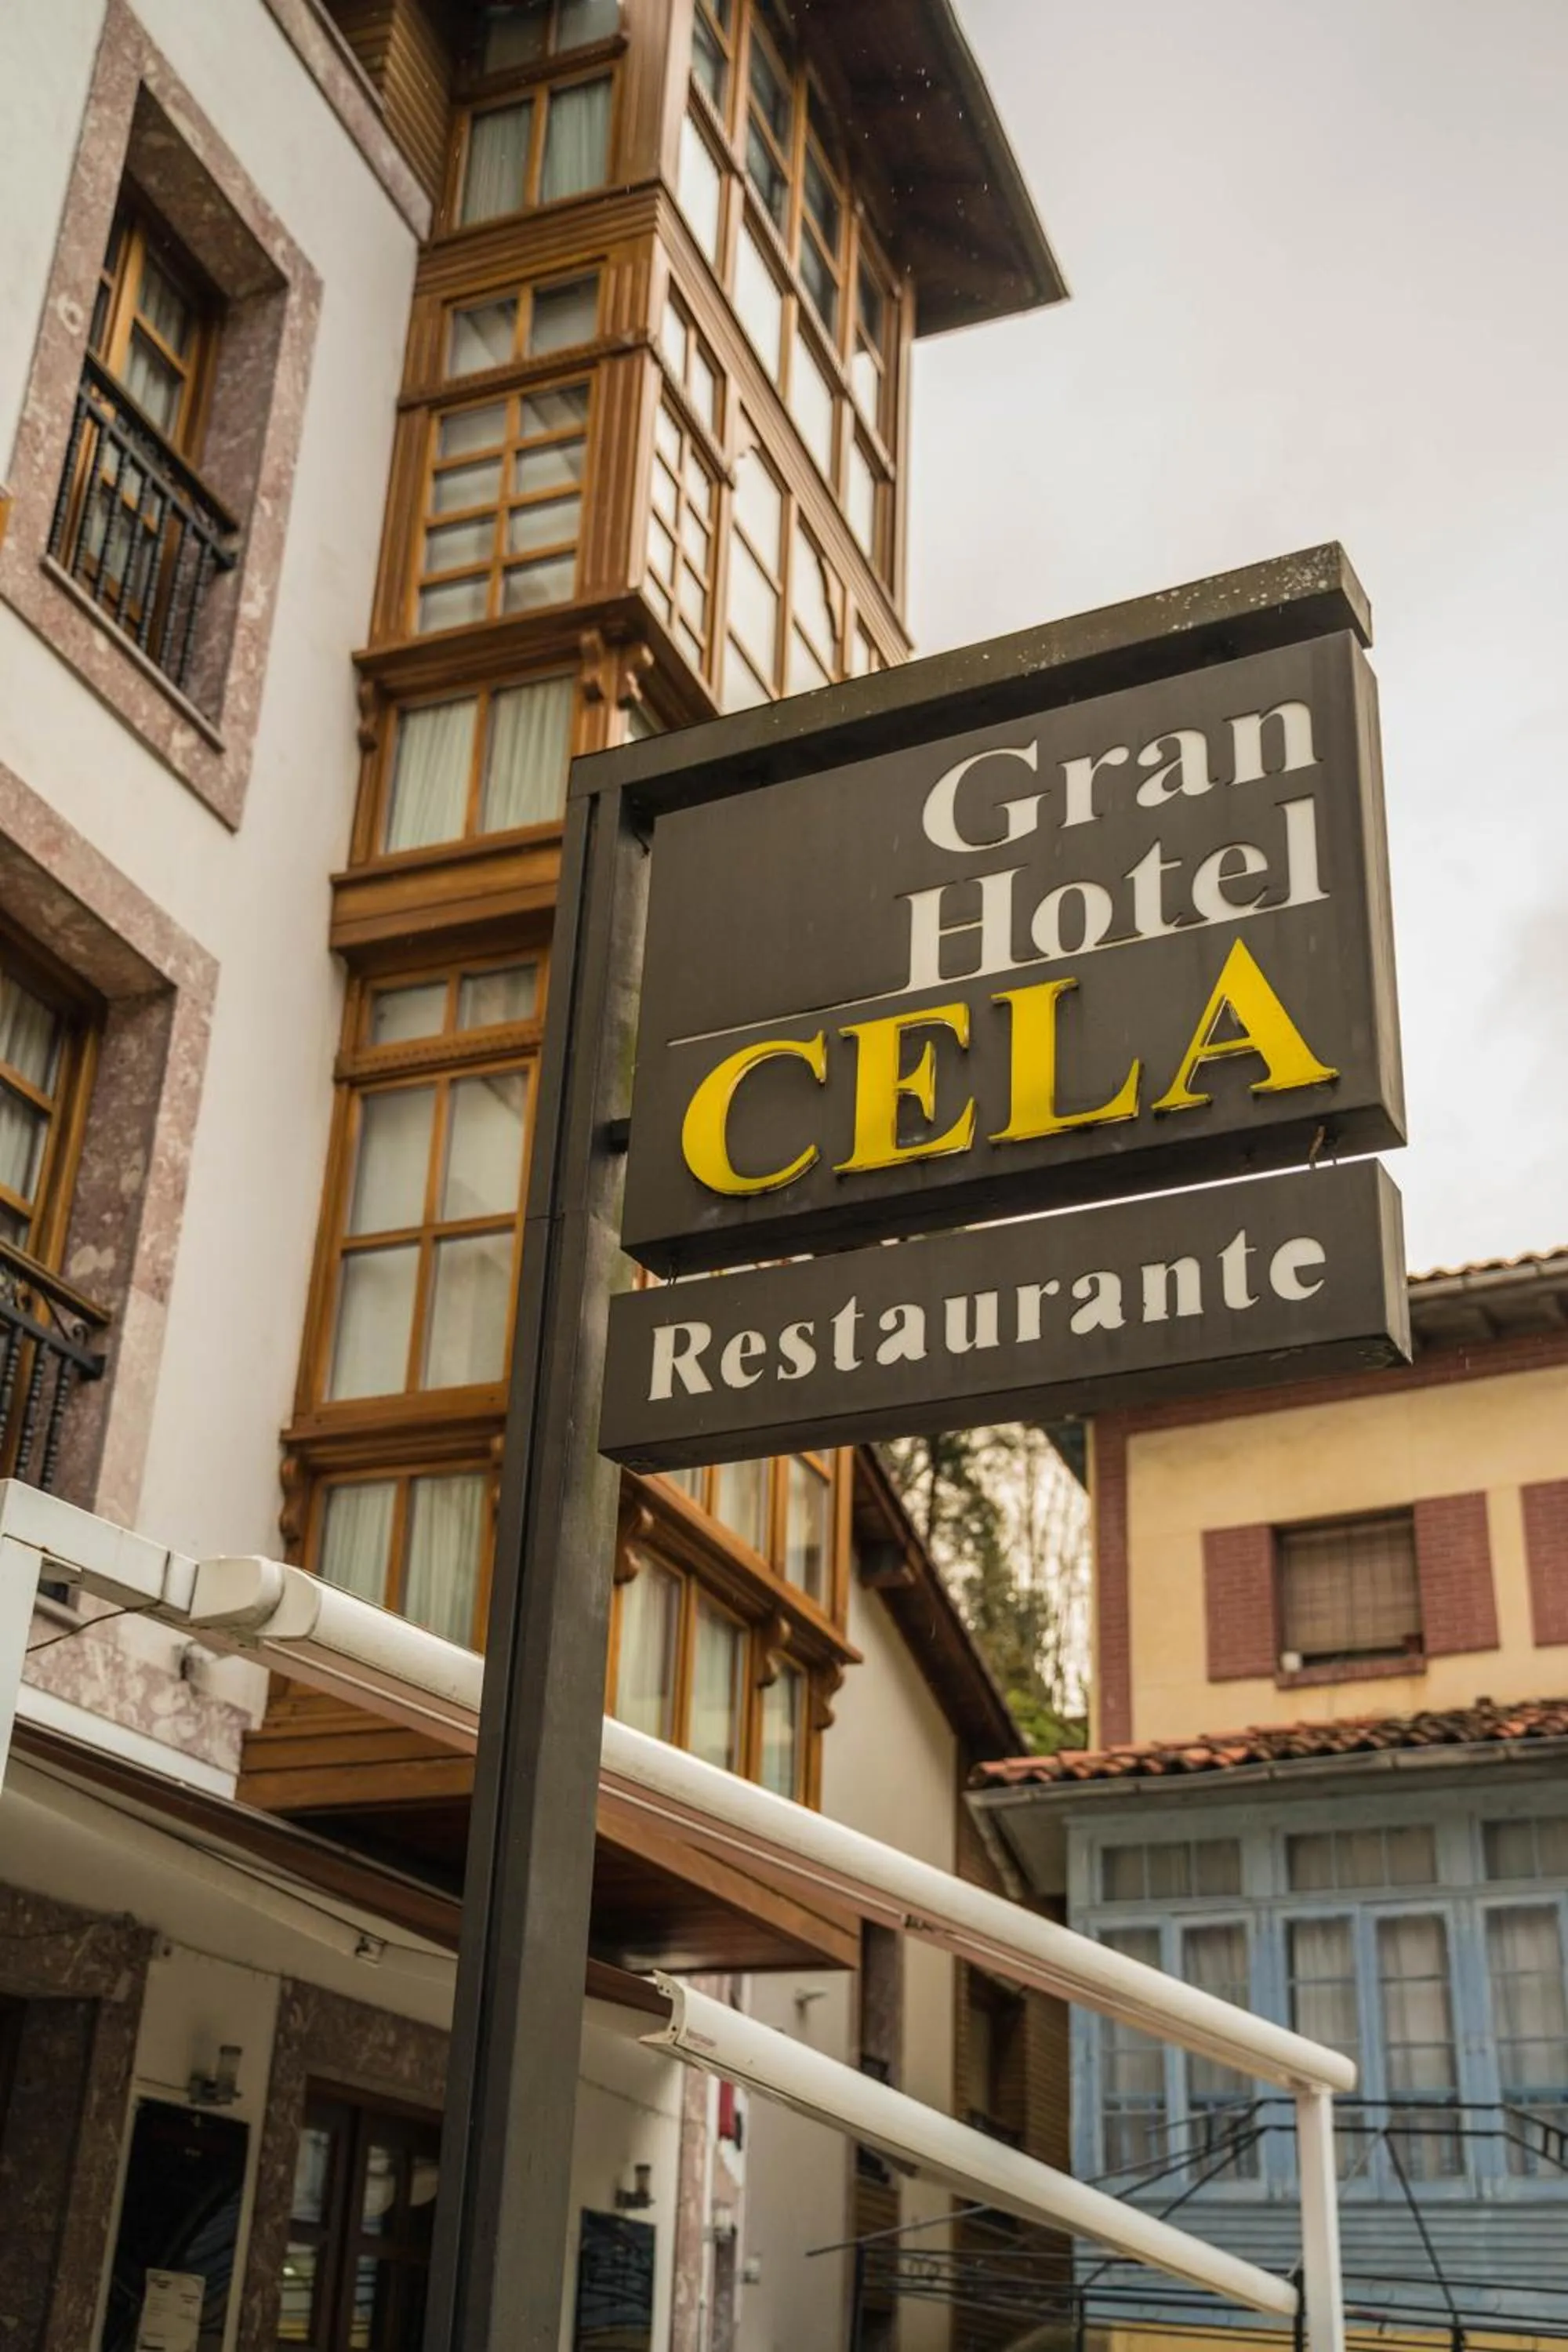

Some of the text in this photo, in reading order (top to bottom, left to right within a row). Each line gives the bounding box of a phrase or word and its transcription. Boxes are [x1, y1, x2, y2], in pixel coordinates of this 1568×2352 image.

[922, 699, 1323, 854] Gran
[904, 795, 1330, 995] Hotel
[681, 938, 1339, 1196] CELA
[648, 1229, 1327, 1401] Restaurante
